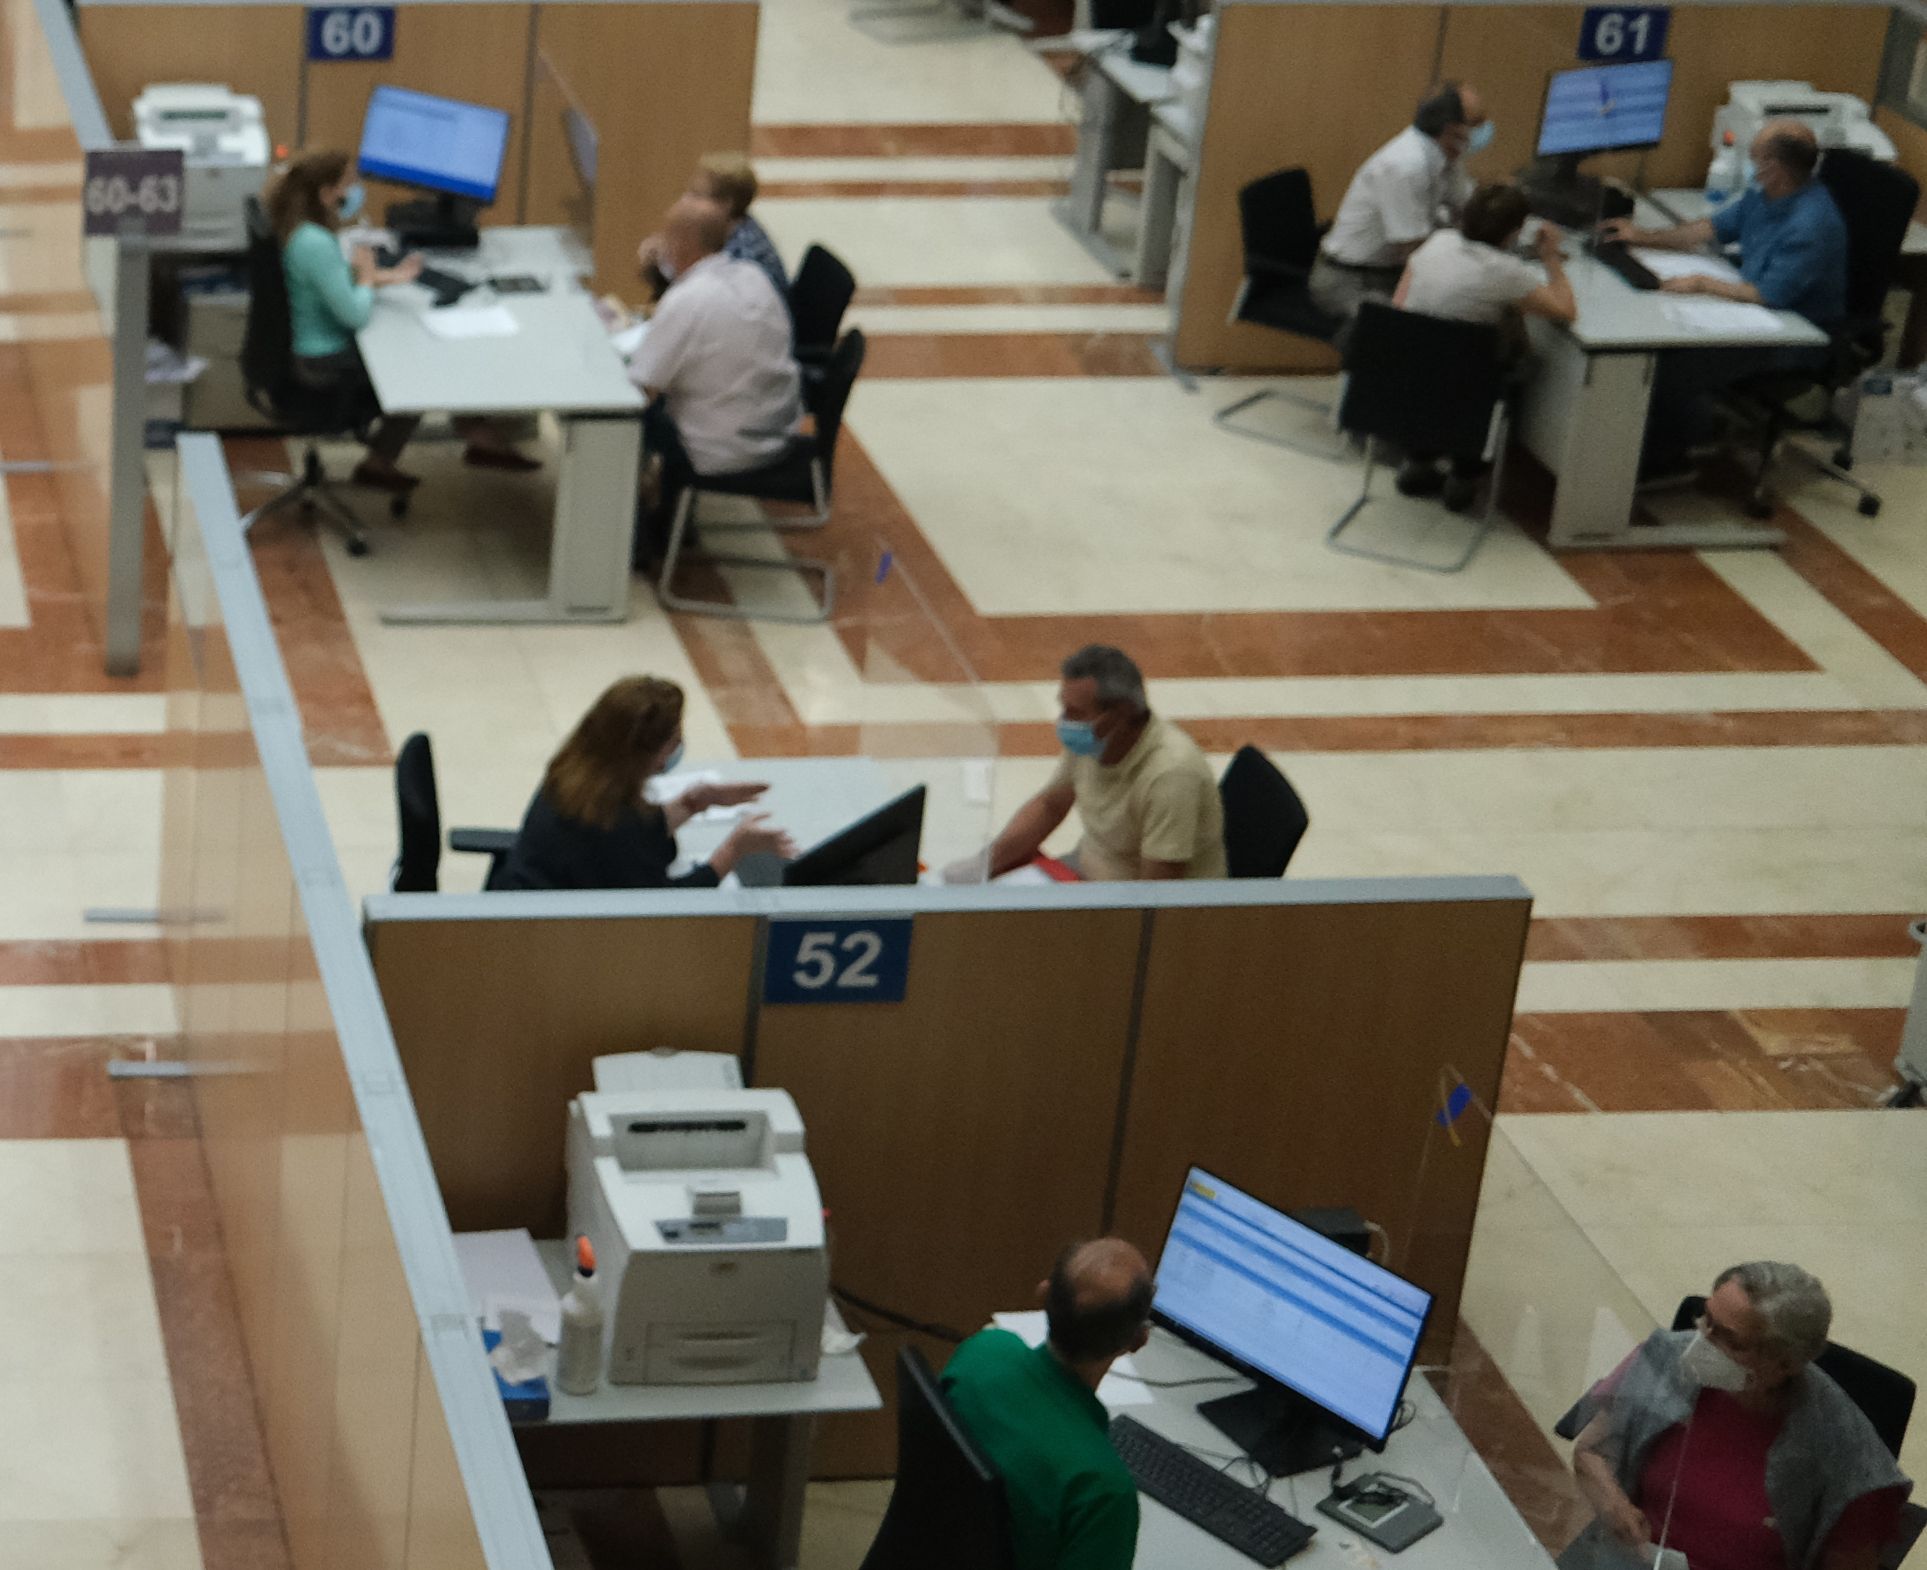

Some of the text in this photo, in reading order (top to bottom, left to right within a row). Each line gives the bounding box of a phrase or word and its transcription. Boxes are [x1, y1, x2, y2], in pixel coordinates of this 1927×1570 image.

[322, 12, 382, 55] 60
[1595, 13, 1650, 55] 61
[87, 175, 179, 213] 60-63
[793, 930, 882, 988] 52
